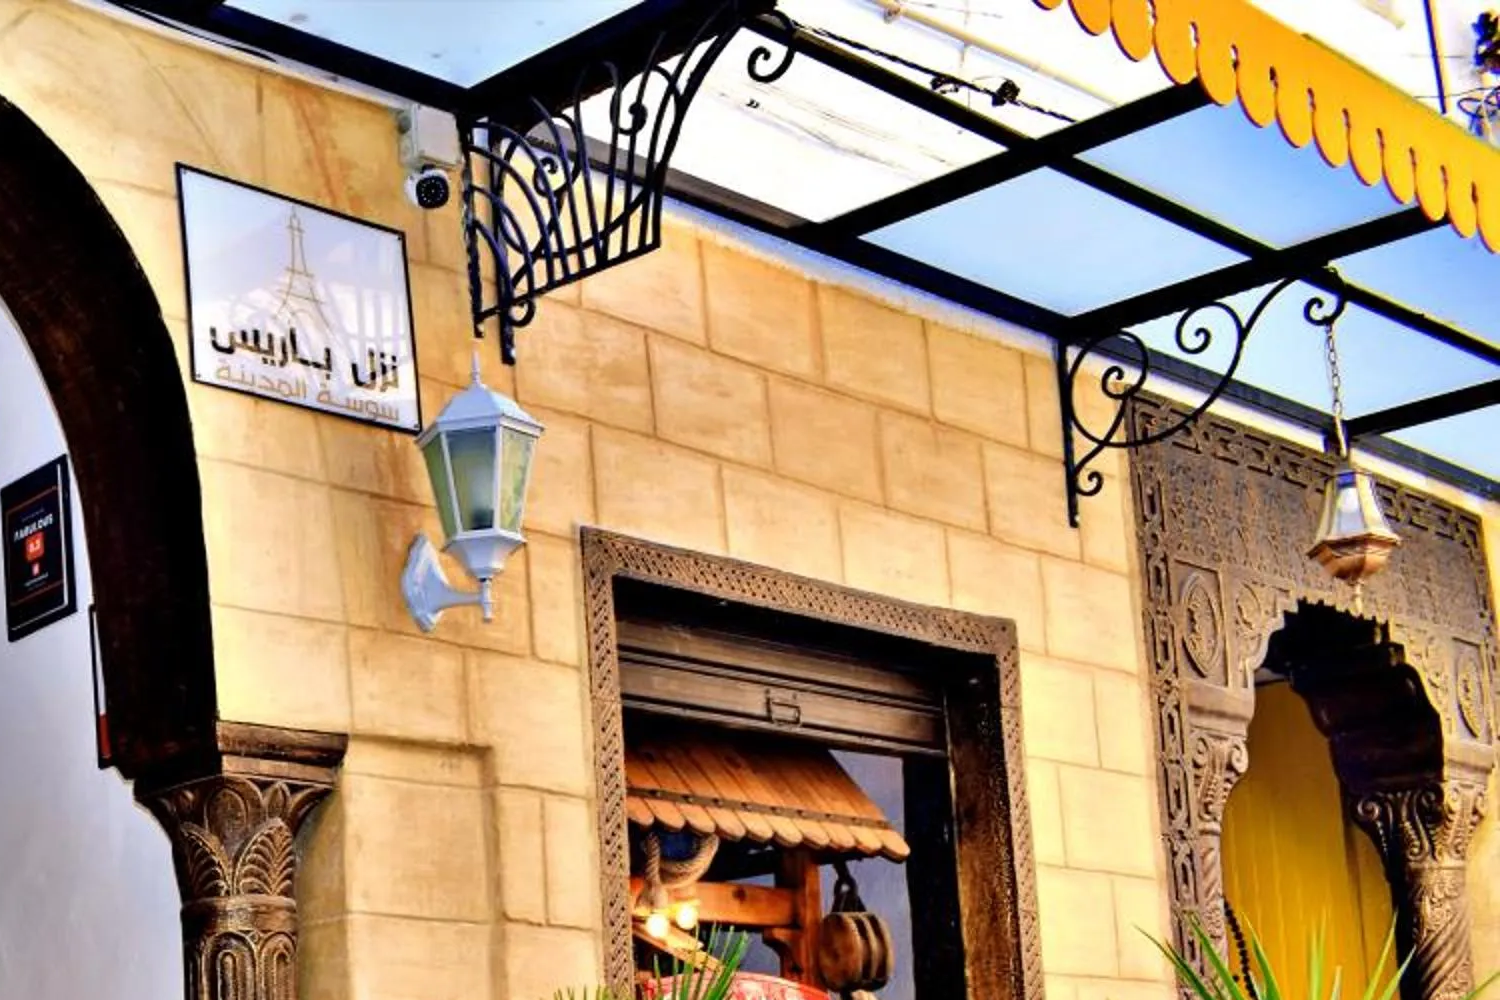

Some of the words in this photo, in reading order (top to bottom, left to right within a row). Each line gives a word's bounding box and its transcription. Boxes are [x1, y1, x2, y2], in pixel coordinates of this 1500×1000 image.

[209, 326, 333, 380] باريس
[351, 347, 399, 392] نزل
[216, 358, 308, 400] المدينة
[316, 381, 399, 421] سوسة
